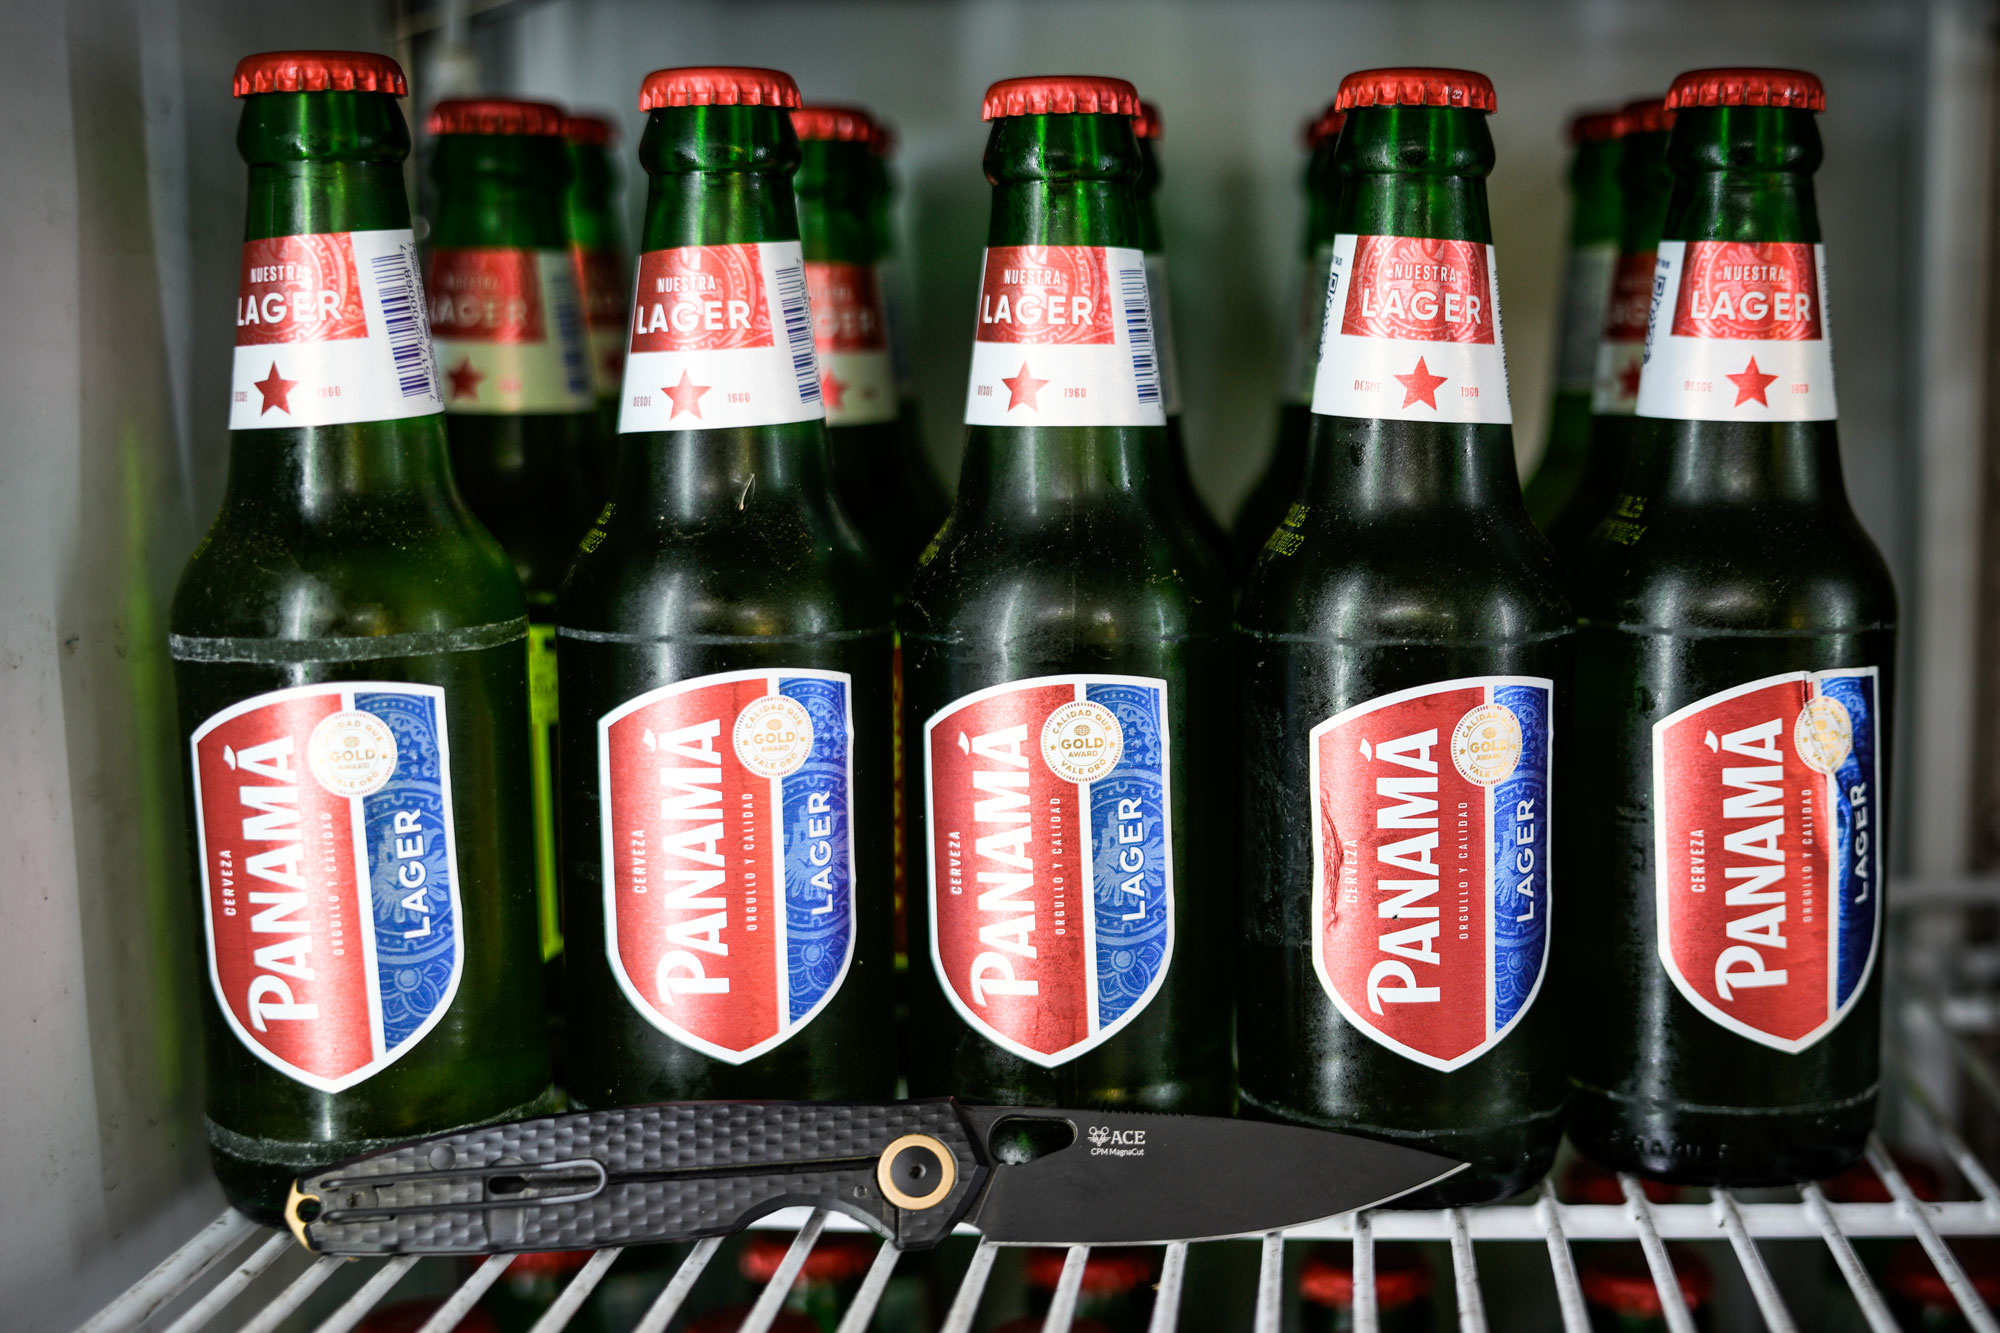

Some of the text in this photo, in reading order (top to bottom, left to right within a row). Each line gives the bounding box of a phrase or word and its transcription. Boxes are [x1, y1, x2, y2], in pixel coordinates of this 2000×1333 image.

[249, 263, 311, 284] NUESTRA
[657, 276, 716, 294] NUESTRA
[1003, 269, 1062, 286] NUESTRA
[1393, 263, 1457, 283] NUESTRA
[1723, 265, 1786, 282] NUESTRA
[236, 289, 343, 327] LAGER
[636, 300, 752, 335] LAGER
[981, 294, 1094, 326] LAGER
[1361, 288, 1482, 324] LAGER
[1690, 290, 1812, 322] LAGER
[633, 392, 751, 407] DESDE 1960
[1064, 387, 1087, 398] 1960
[1354, 379, 1479, 398] DESDE 1960
[745, 704, 784, 729] CALIDAD
[1052, 709, 1112, 735] CALIDAD QUE
[1462, 712, 1499, 739] CALIDAD
[330, 749, 376, 762] GOLD
[754, 731, 796, 745] GOLD
[1061, 737, 1104, 750] GOLD
[1068, 750, 1099, 758] AWARD
[1470, 740, 1507, 753] GOLD
[1061, 758, 1106, 775] VALE ORO
[807, 791, 833, 915] LAGER
[1118, 797, 1145, 921] LAGER
[1516, 798, 1536, 923] LAGER
[1703, 717, 1788, 1002] PANAMÁ
[1801, 788, 1812, 923] ORGULLO Y CALIDAD
[1849, 781, 1870, 905] LAGER
[395, 808, 431, 939] LAGER
[634, 829, 647, 893] CERVEZA
[642, 719, 731, 1007] PANAMÁ
[743, 792, 758, 931] ORGULLO Y CALIDAD
[950, 831, 963, 895] CERVEZA
[958, 724, 1040, 1008] PANAMÁ
[1052, 796, 1065, 935] ORGULLO Y CALIDAD
[1344, 838, 1358, 904] CERVEZA
[1358, 727, 1442, 1017] PANAMÁ
[1457, 801, 1469, 941] ORGULLO Y CALIDAD
[1691, 829, 1707, 893] CERVEZA
[221, 850, 236, 916] CERVEZA
[223, 736, 320, 1033] PANAMÁ
[324, 812, 345, 956] ORGULLO Y CALIDAD
[1090, 1147, 1145, 1157] CPM MagnaCut
[1110, 1130, 1146, 1145] ACE
